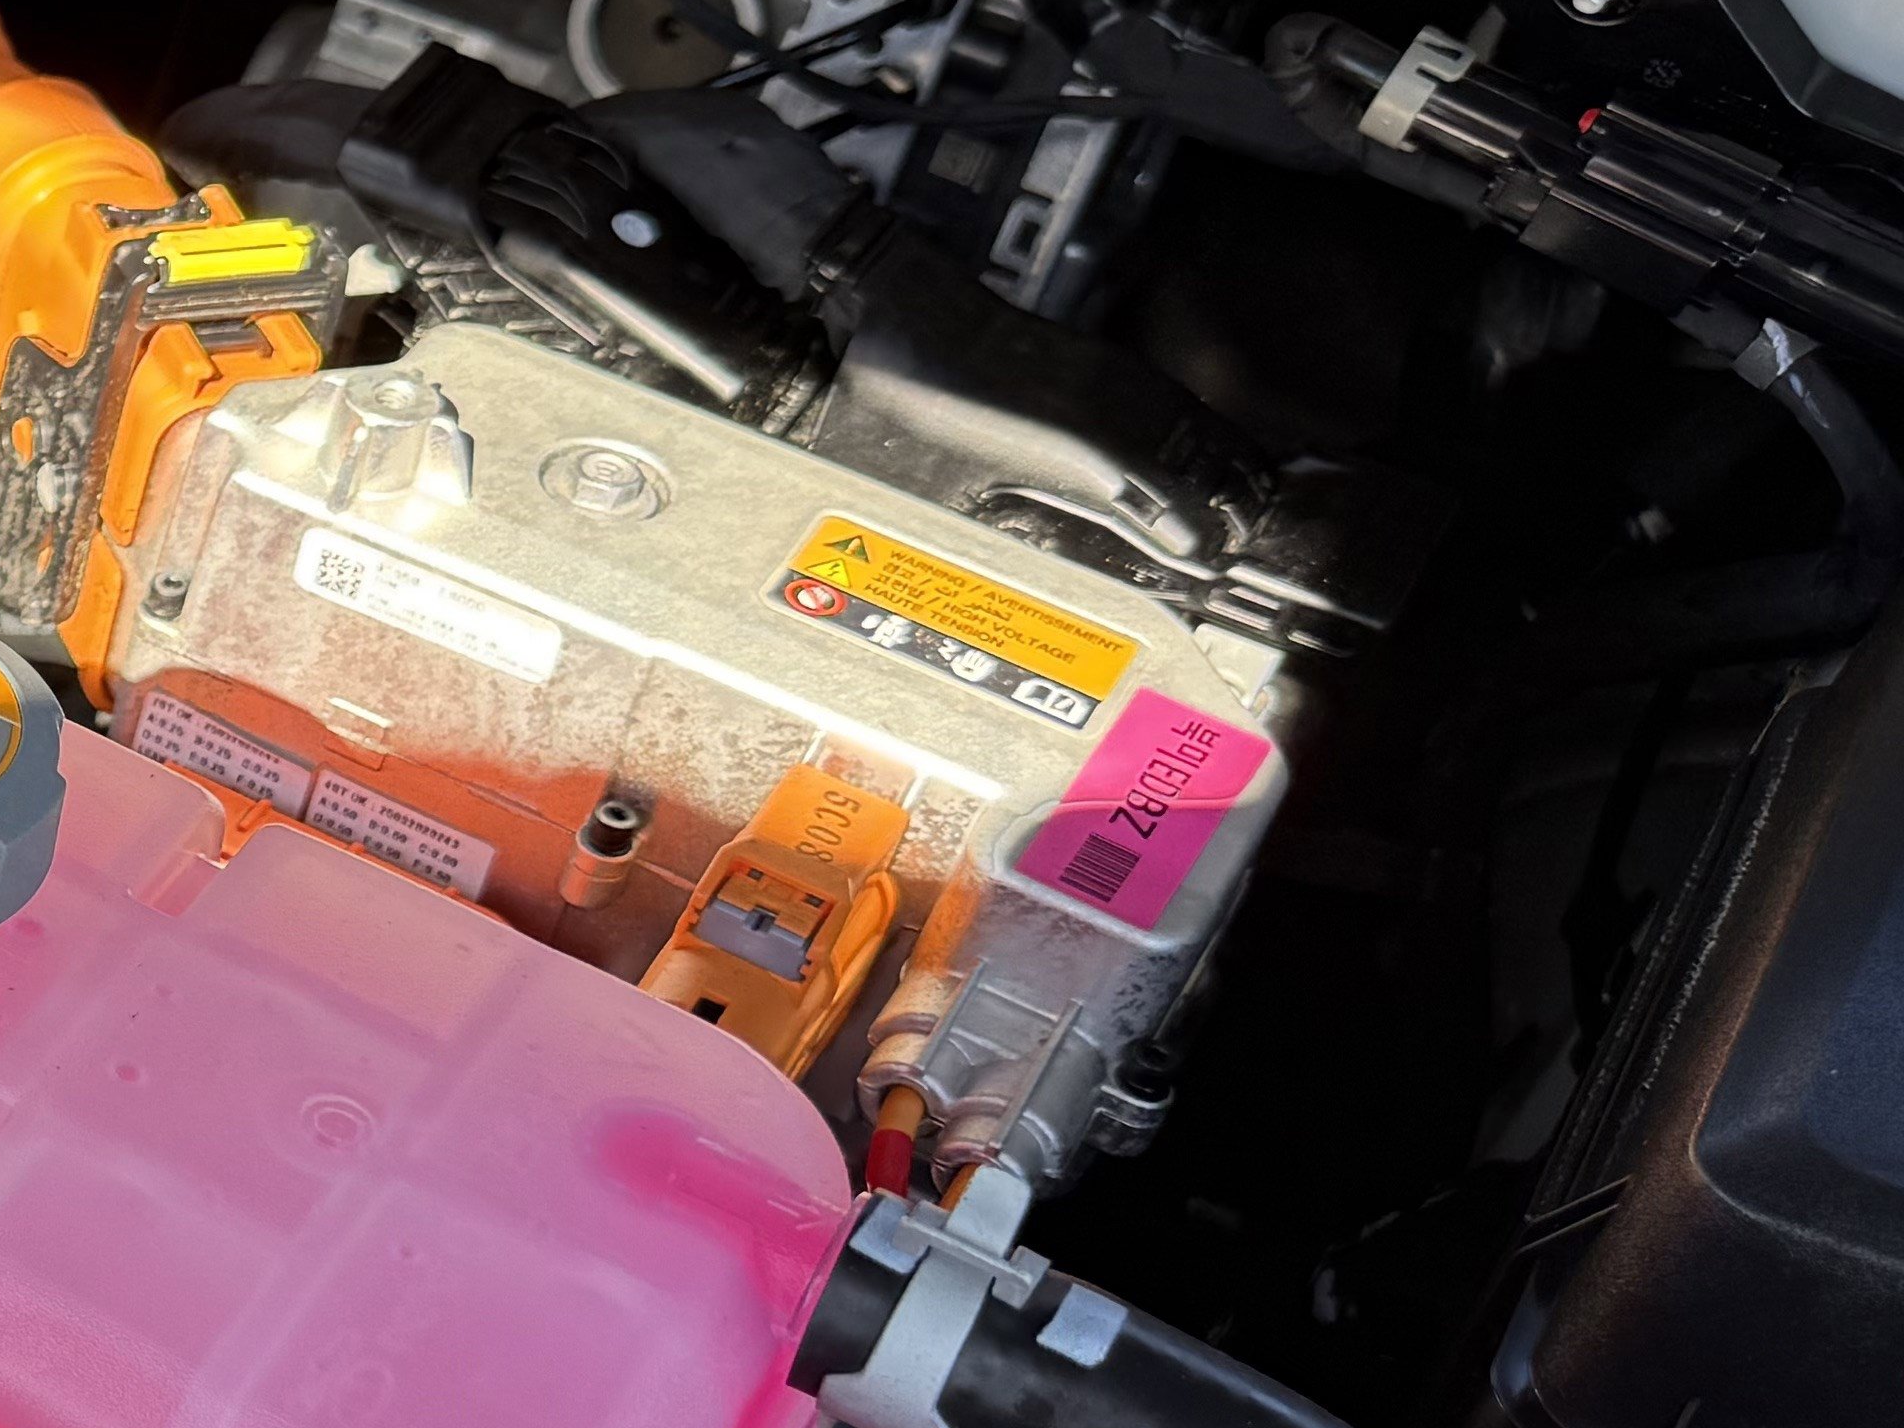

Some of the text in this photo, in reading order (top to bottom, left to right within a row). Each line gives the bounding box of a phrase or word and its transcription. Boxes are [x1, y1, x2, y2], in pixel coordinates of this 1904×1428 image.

[863, 581, 1005, 649] HAUTE TENSION
[888, 547, 967, 590] WARNING
[984, 589, 1123, 654] AVERTISSEMENT
[941, 600, 987, 627] HIGH
[989, 621, 1077, 666] VOLTAGE
[796, 790, 861, 864] 5C08
